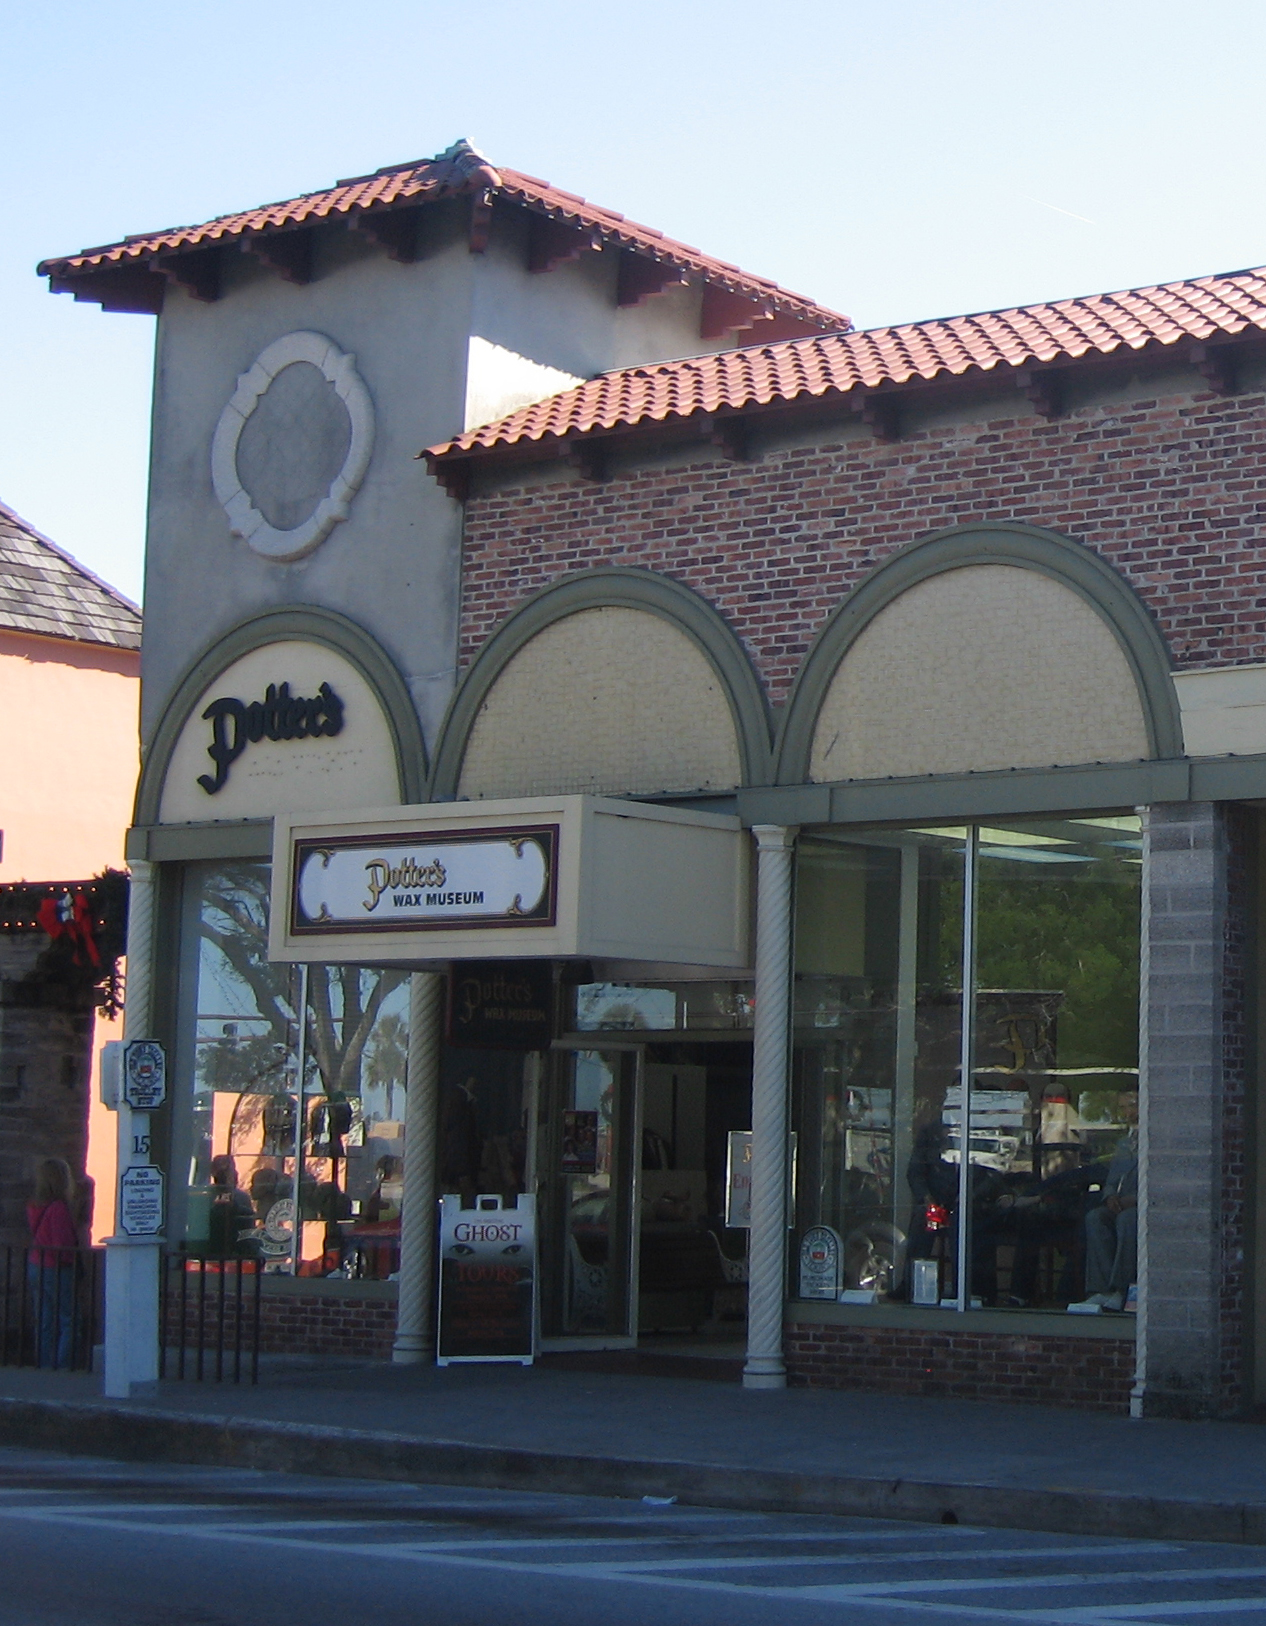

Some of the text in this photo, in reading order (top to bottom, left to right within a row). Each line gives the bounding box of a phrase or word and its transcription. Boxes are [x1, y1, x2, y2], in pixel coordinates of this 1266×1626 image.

[197, 681, 345, 795] Potter's
[362, 857, 447, 912] Potter's
[393, 890, 484, 907] WAX MUSEUM
[133, 1135, 150, 1154] 15
[454, 1223, 522, 1242] GHOST
[456, 1262, 520, 1284] TOURS
